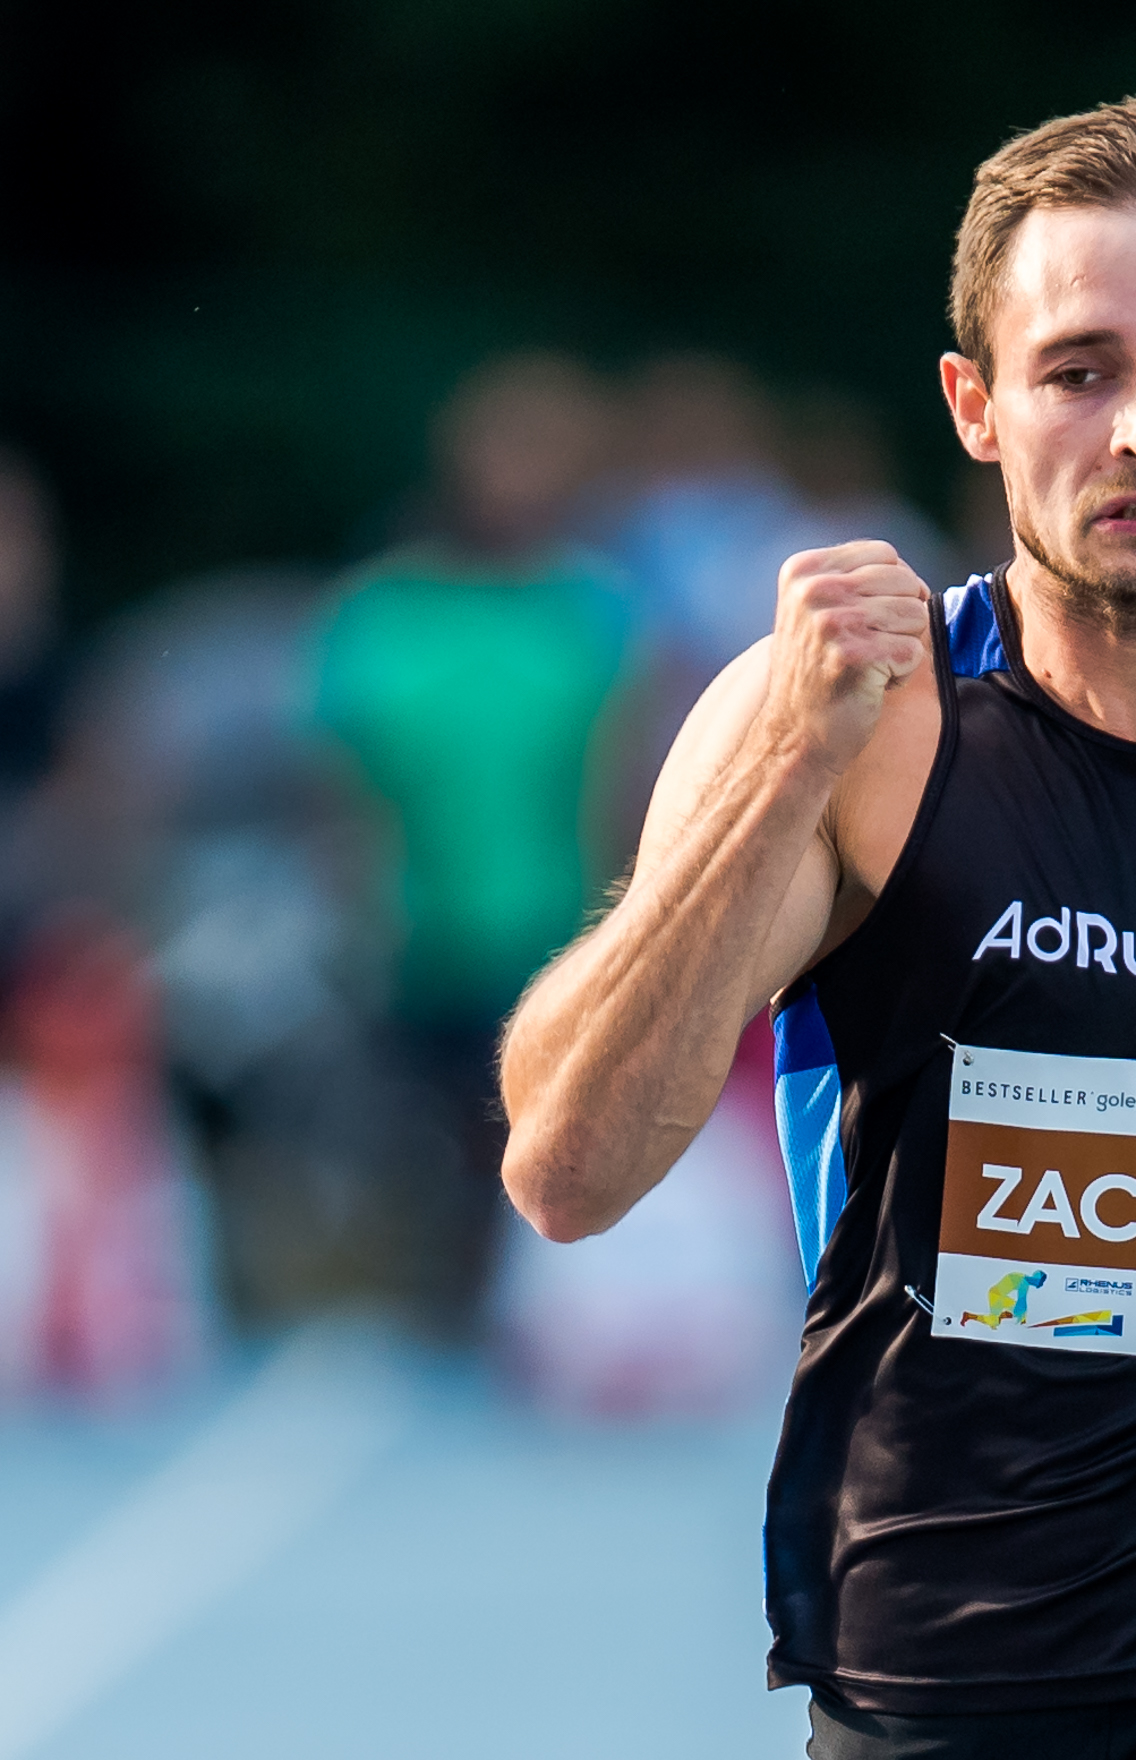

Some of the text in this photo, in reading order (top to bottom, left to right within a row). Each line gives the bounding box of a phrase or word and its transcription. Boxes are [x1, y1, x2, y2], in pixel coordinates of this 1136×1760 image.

[961, 1080, 1087, 1105] BESTSELLER
[1080, 1279, 1133, 1289] RHENUS
[1079, 1287, 1132, 1296] LOGISTICS
